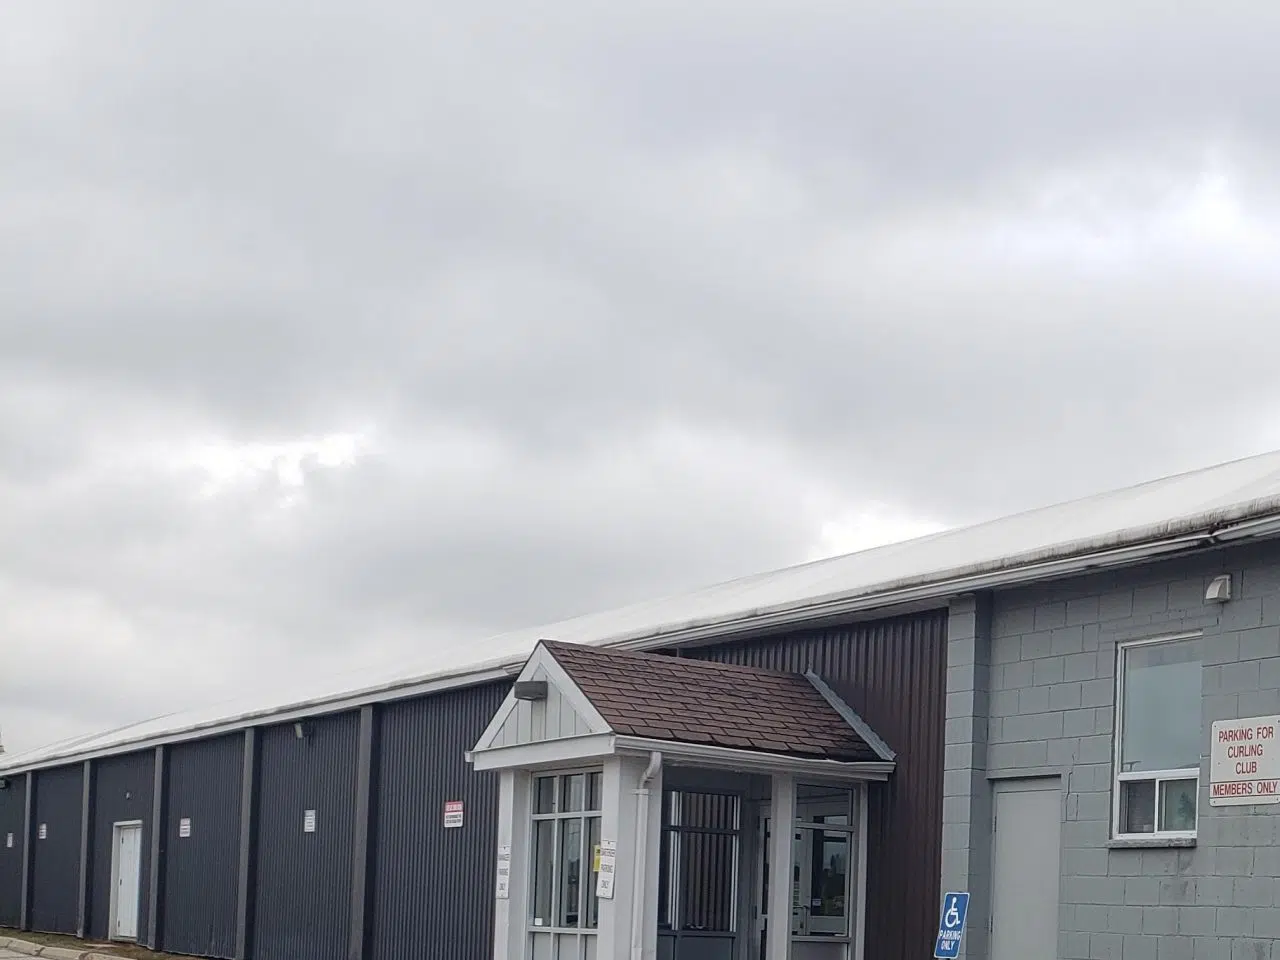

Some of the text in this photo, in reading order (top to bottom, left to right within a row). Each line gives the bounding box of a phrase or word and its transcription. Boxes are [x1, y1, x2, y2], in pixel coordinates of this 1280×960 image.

[1218, 726, 1274, 742] PARKING FOR
[1227, 744, 1263, 759] CURLING
[1235, 761, 1258, 774] CLUB
[1212, 781, 1278, 796] MEMBERS ONLY
[938, 929, 961, 940] PARKING
[940, 940, 956, 950] ONLY
